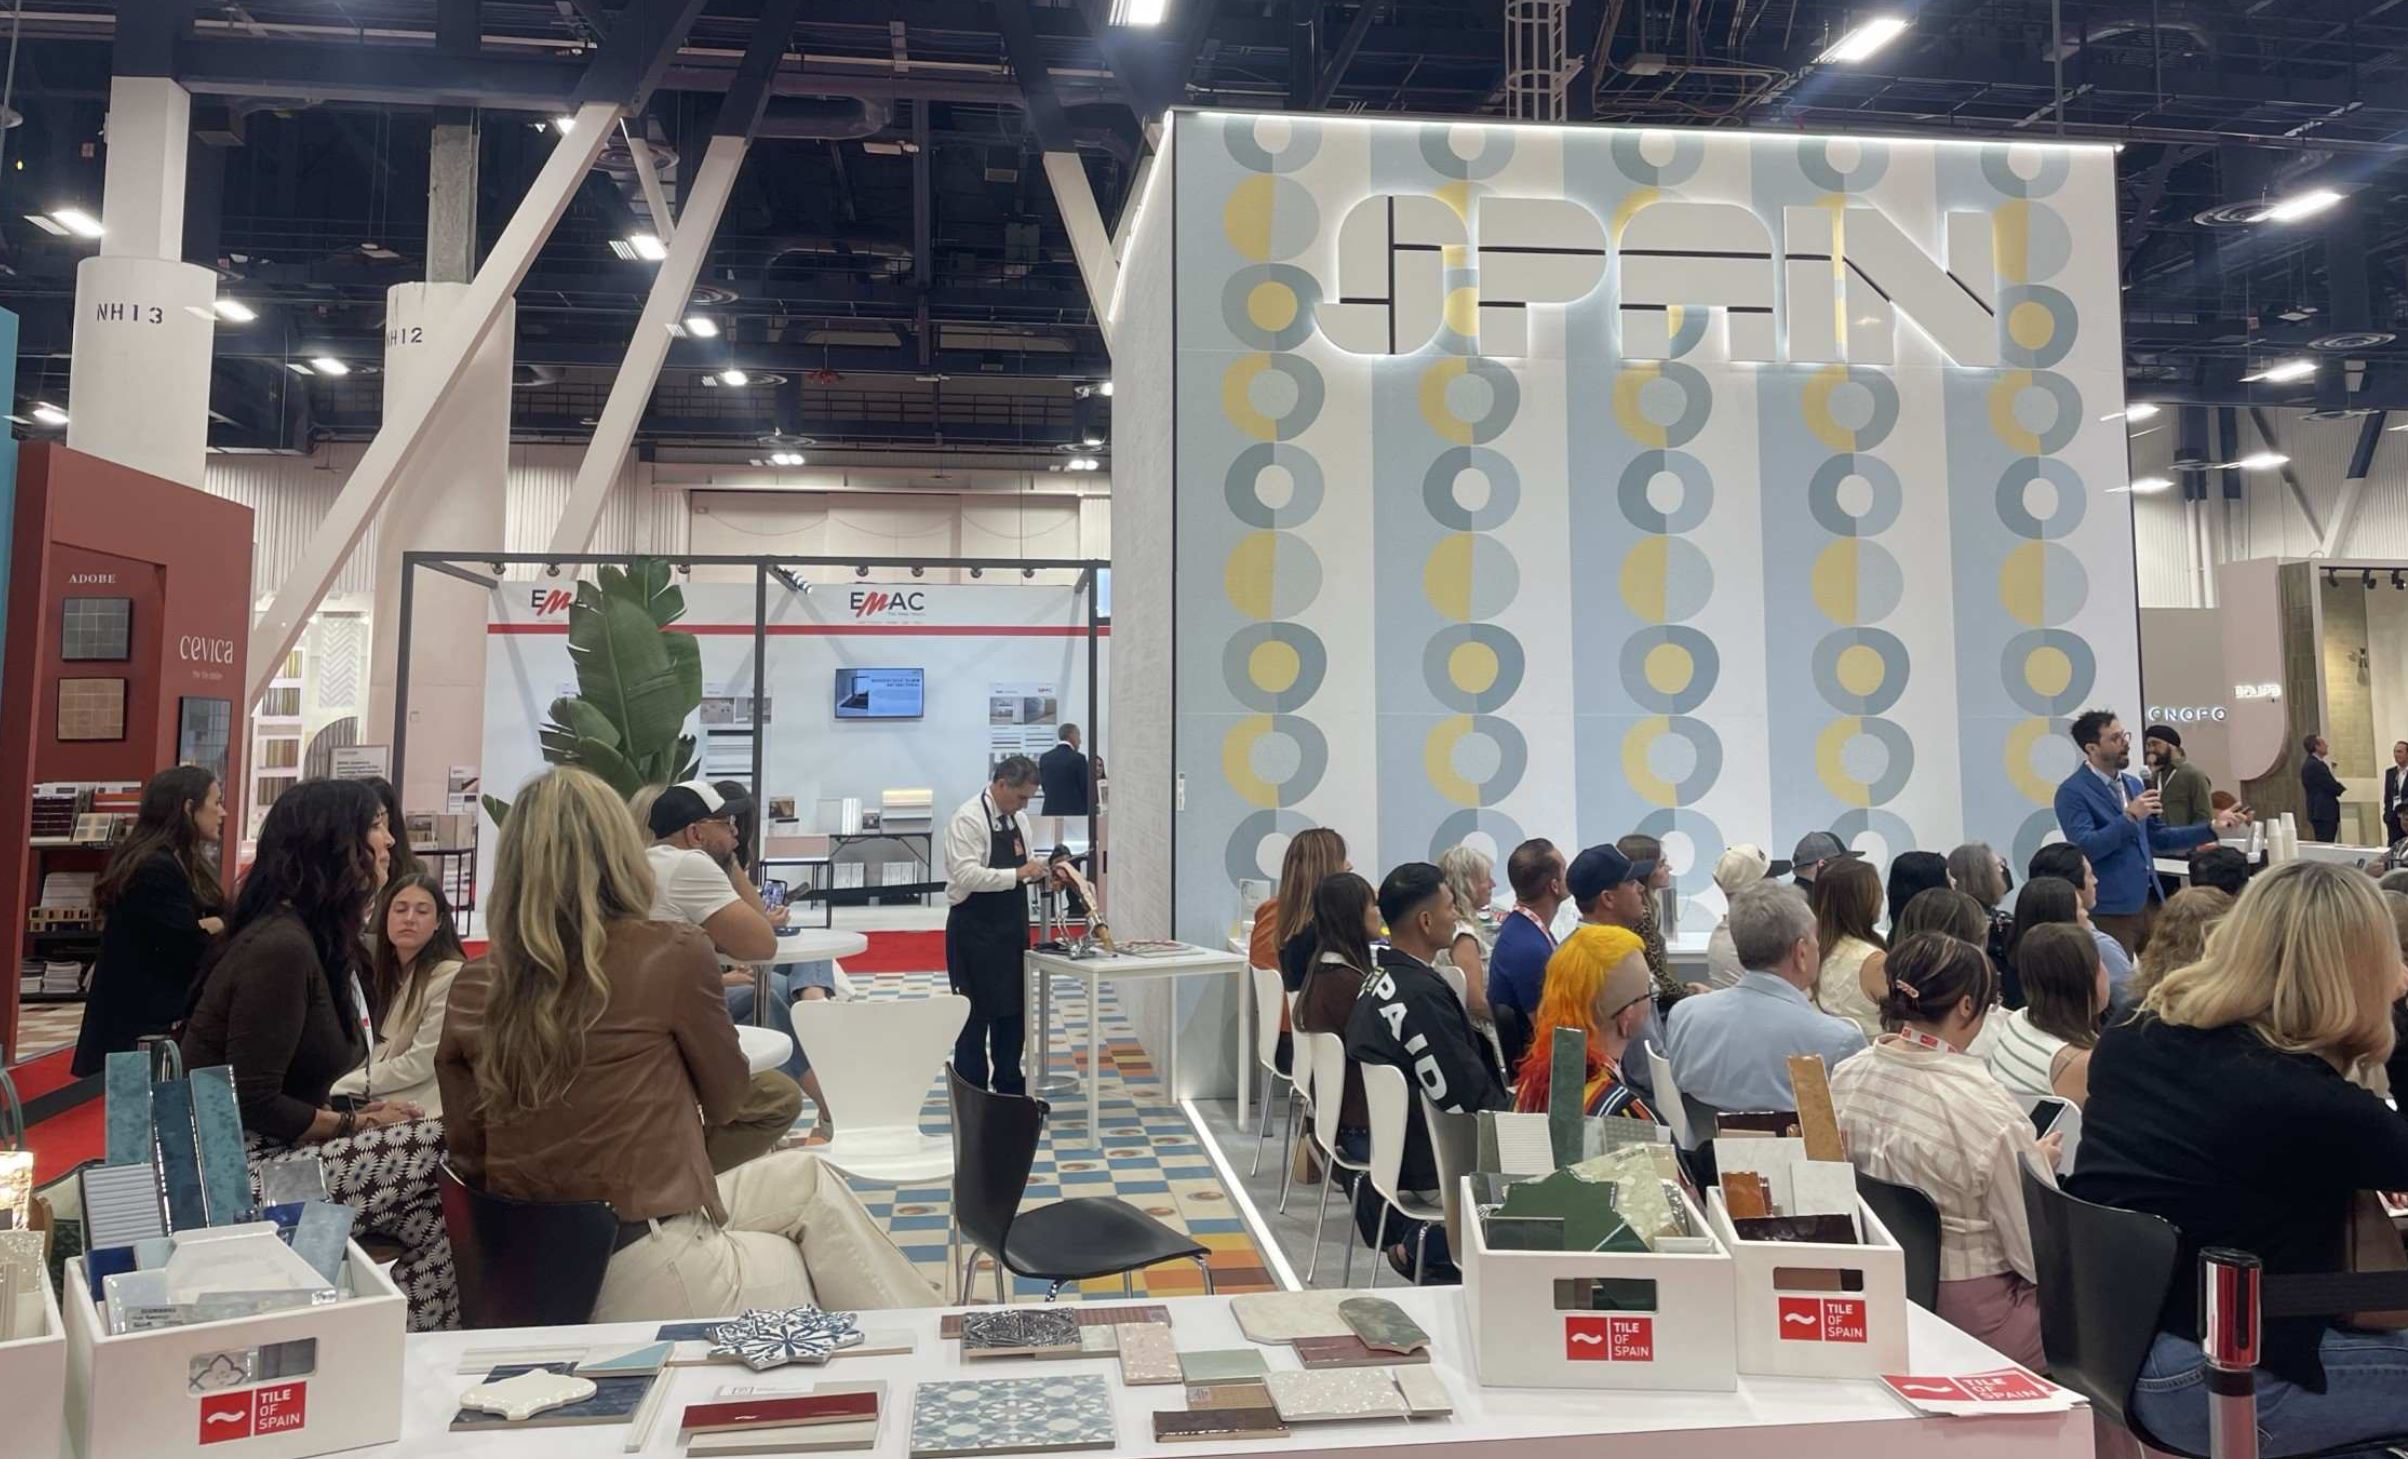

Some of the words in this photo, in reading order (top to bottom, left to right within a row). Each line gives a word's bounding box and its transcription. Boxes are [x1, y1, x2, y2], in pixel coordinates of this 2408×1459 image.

[1312, 193, 1998, 369] SPAIN
[68, 573, 117, 584] ADOBE
[531, 590, 572, 616] EM
[850, 591, 925, 618] EMAC
[1827, 1303, 1853, 1315] TILE
[1827, 1315, 1842, 1326] OF
[1613, 1322, 1639, 1333] TILE
[1827, 1326, 1863, 1338] SPAIN
[1614, 1334, 1630, 1345] OF
[1614, 1346, 1649, 1357] SPAIN
[1962, 1378, 2007, 1387] TILE
[1971, 1384, 1995, 1392] OF
[260, 1389, 292, 1404] TILE
[1980, 1389, 2039, 1400] SPAIN
[260, 1403, 278, 1417] OF
[258, 1412, 300, 1430] SPAIN
